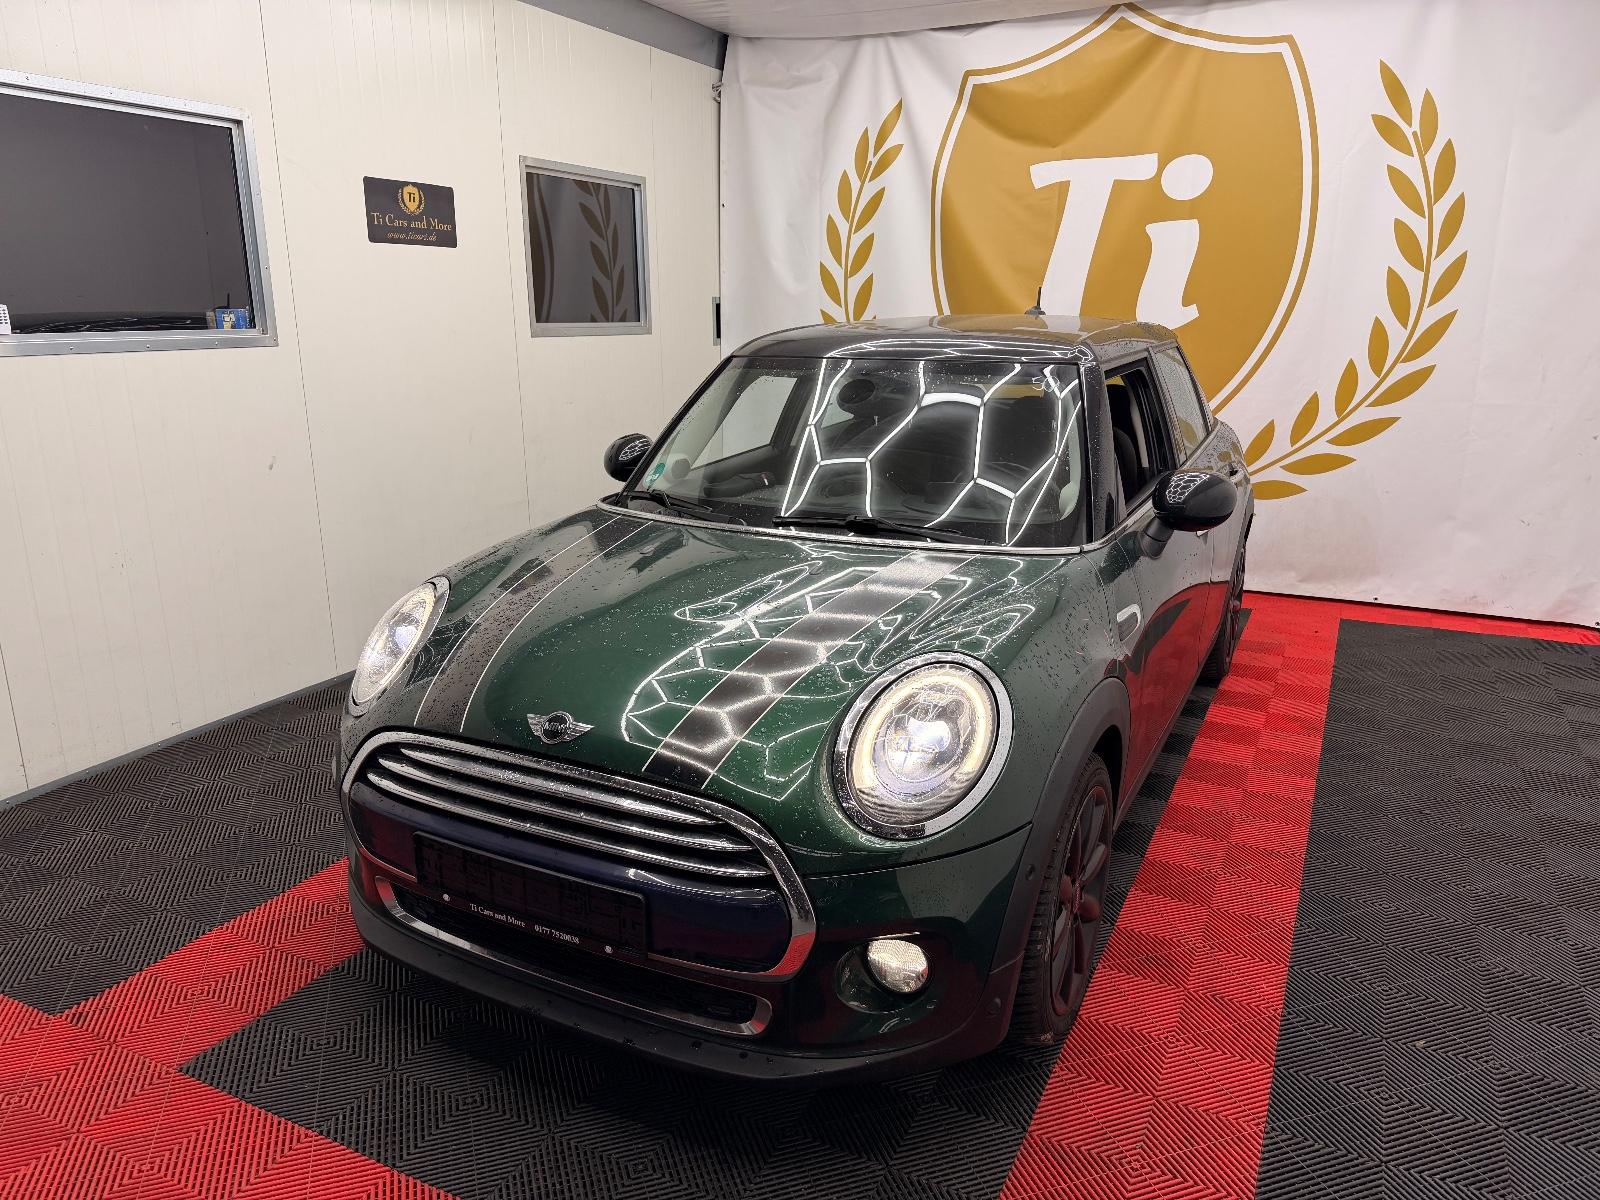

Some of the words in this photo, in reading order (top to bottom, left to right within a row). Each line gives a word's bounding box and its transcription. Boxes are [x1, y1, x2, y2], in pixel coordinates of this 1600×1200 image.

[407, 192, 416, 203] Ti
[371, 212, 382, 225] Ti
[385, 214, 407, 228] Cars
[411, 216, 427, 229] and
[429, 217, 452, 231] More
[1029, 152, 1213, 330] Ti
[469, 903, 477, 912] Ti
[478, 906, 493, 917] Cars
[494, 912, 506, 922] and
[507, 915, 526, 927] More
[534, 924, 550, 934] 0177
